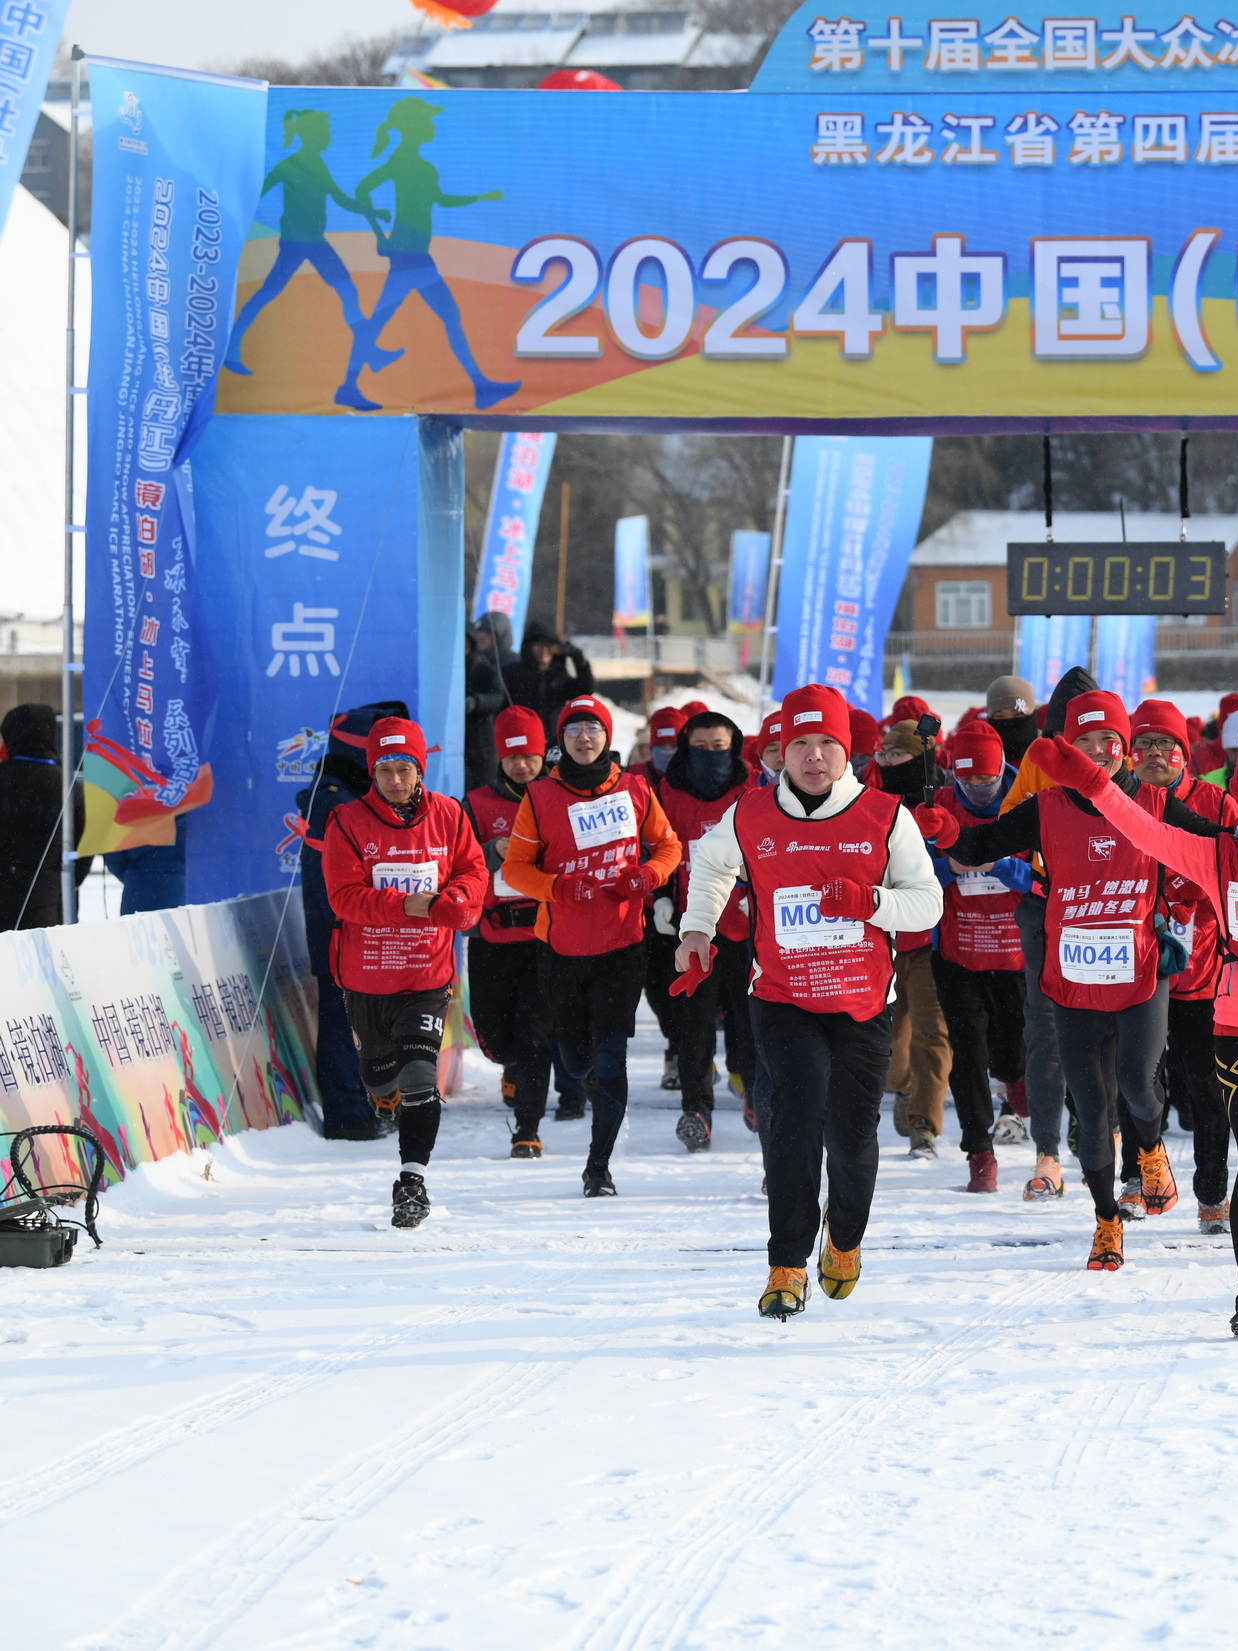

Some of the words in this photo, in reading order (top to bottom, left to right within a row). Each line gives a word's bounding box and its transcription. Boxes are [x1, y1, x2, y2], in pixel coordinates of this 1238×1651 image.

[124, 175, 134, 216] 2024
[121, 220, 133, 273] CHINA
[116, 278, 136, 405] (MUDANJIANG)
[131, 260, 147, 376] HEILONGJIANG
[113, 410, 127, 476] JINGBO
[126, 417, 136, 449] AND
[110, 479, 122, 522] LAKE
[121, 453, 133, 501] SNOW
[108, 527, 120, 554] ICE
[265, 484, 342, 678] 终点
[110, 559, 124, 656] MARATHON
[123, 630, 135, 685] SERIES
[577, 805, 629, 832] M118
[1064, 943, 1130, 965] M044
[420, 1013, 444, 1037] 34
